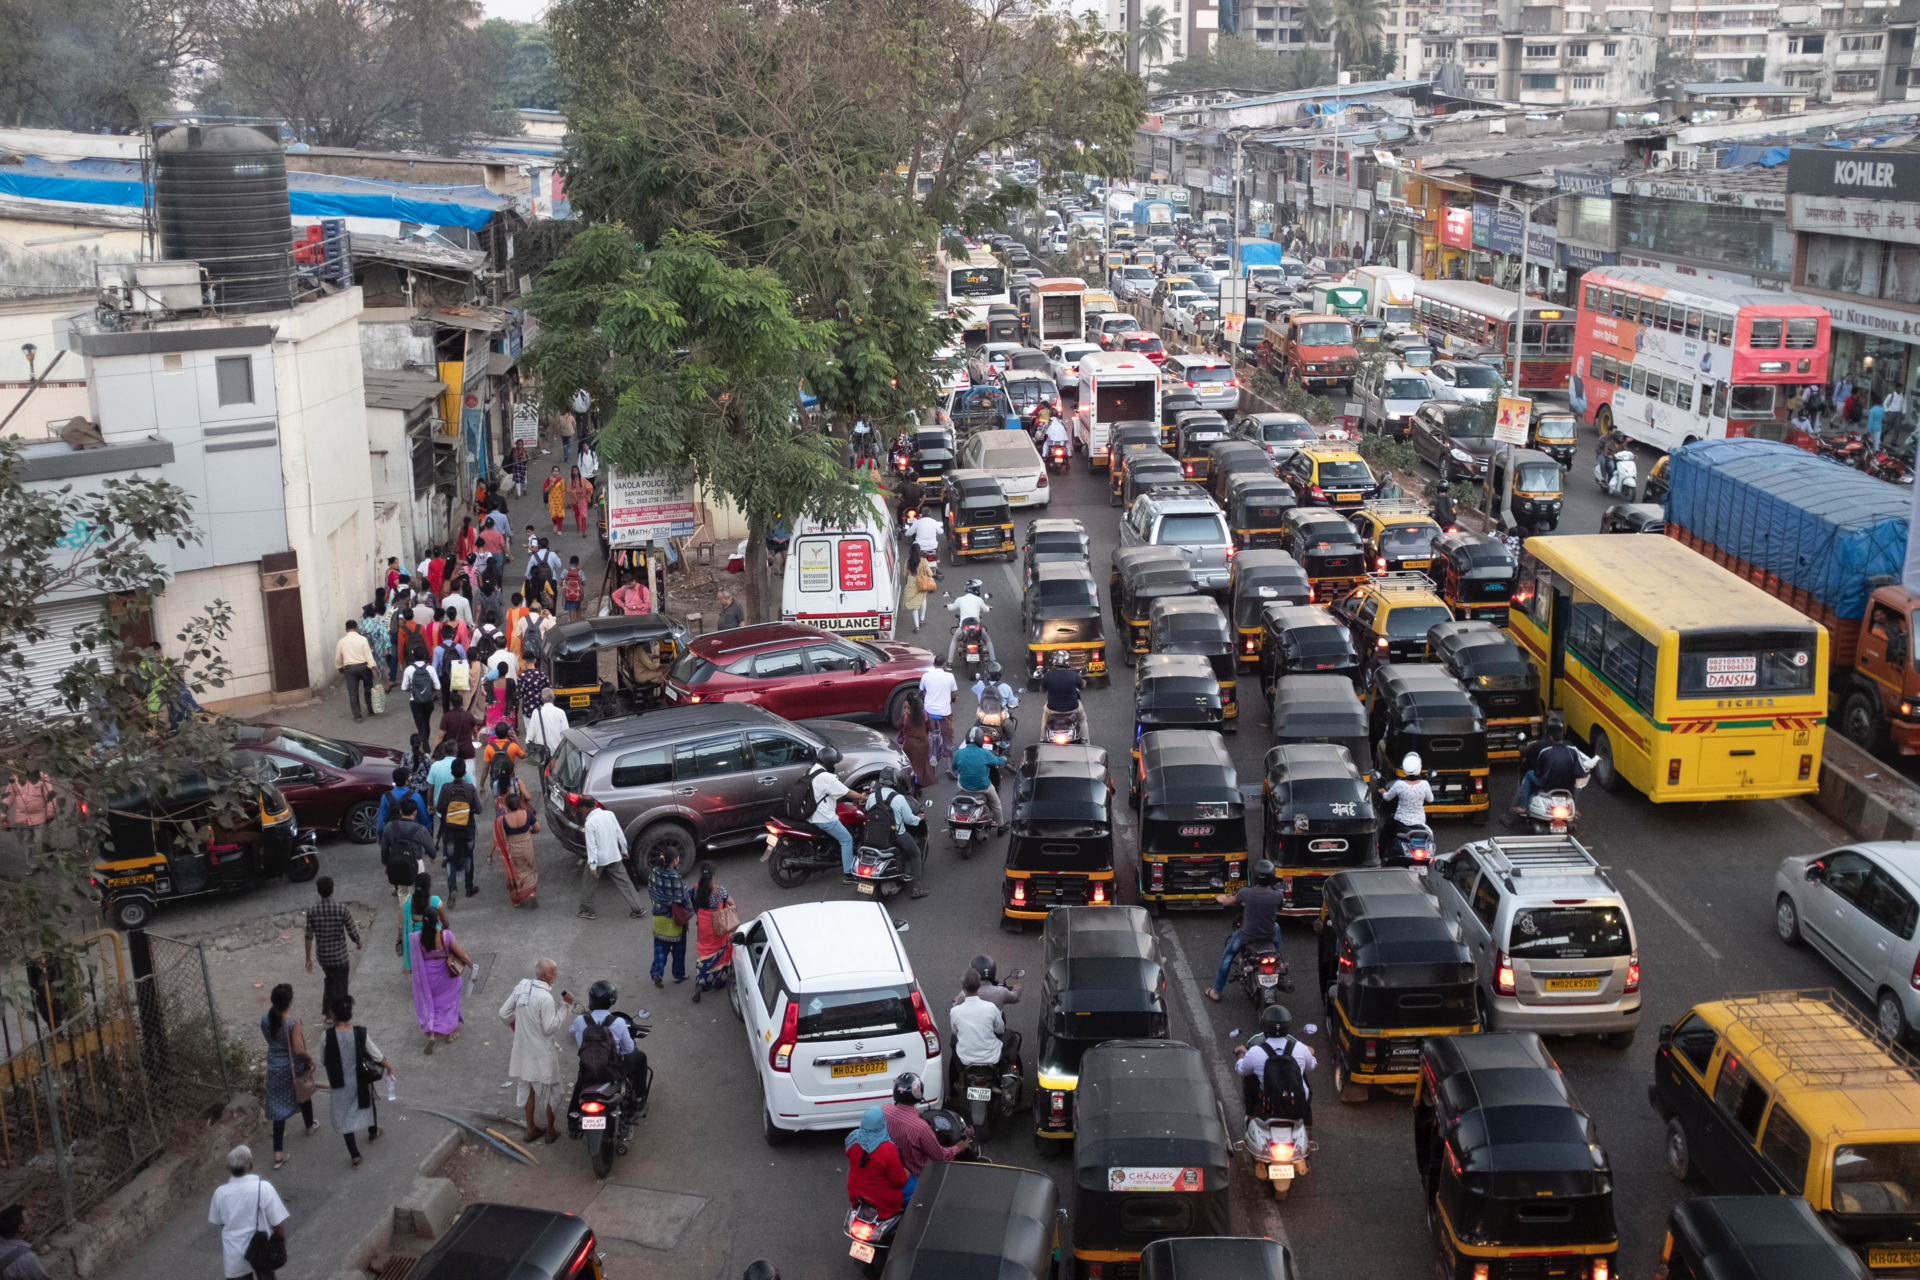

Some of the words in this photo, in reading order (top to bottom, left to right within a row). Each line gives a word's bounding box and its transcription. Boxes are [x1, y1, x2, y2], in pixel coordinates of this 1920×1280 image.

[1834, 160, 1894, 187] KOHLER
[1847, 309, 1899, 332] NURUDDIN
[1902, 320, 1912, 335] &
[613, 482, 641, 490] VAKOLA
[641, 479, 666, 488] POLICE
[624, 490, 654, 498] SANTACRUZ
[628, 528, 648, 536] MATH
[1798, 654, 1806, 664] 8
[1708, 674, 1755, 687] DANSIM
[1717, 698, 1774, 708] EICHER
